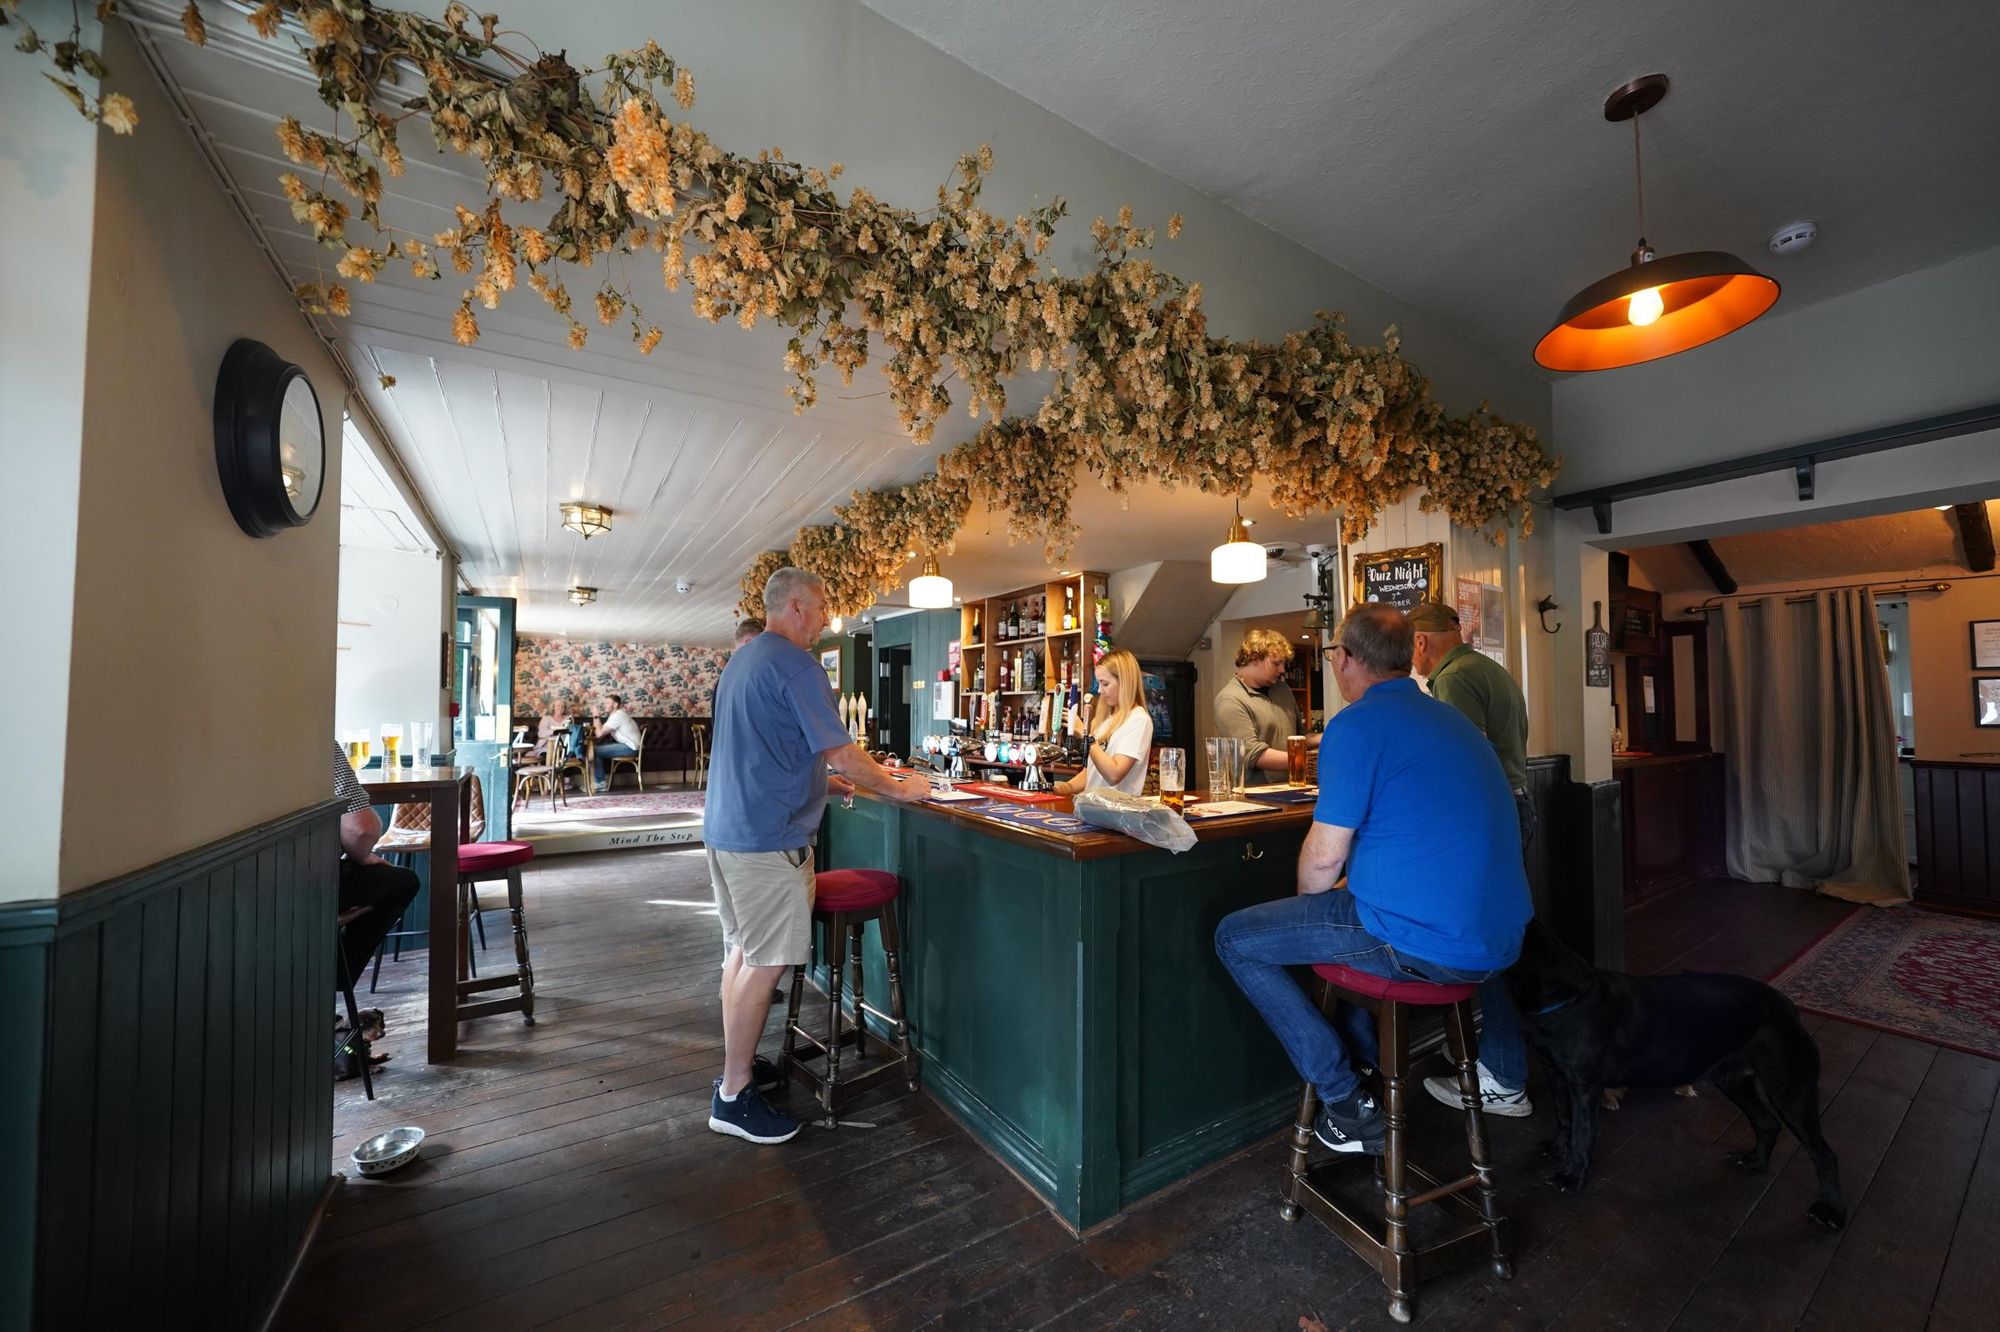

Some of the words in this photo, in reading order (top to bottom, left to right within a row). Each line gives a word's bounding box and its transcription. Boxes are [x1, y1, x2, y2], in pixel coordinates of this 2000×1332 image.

[1370, 568, 1391, 582] Quiz
[1394, 563, 1423, 584] Night
[1379, 582, 1418, 592] WEDNESDAY
[608, 835, 640, 846] Mind
[646, 833, 666, 843] The
[670, 832, 693, 841] Step
